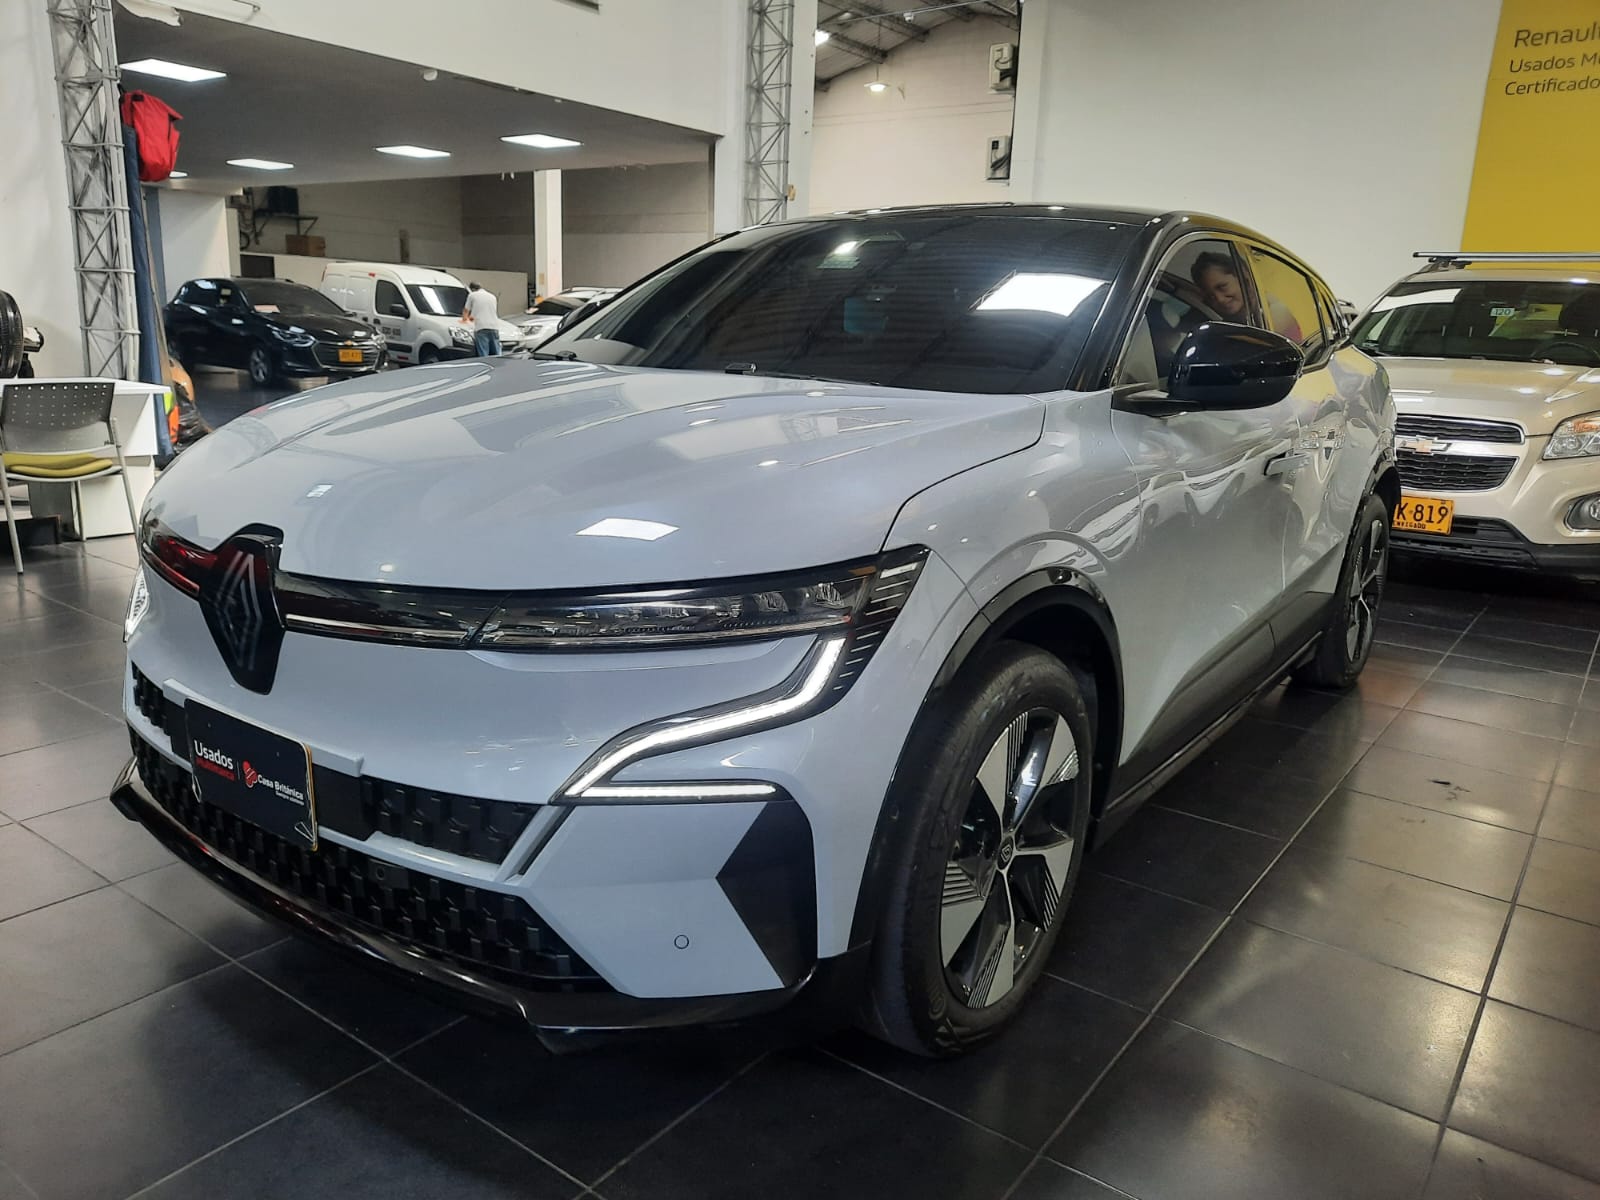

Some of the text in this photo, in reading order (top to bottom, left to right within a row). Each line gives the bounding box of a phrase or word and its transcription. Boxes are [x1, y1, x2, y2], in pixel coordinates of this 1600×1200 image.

[1514, 21, 1600, 48] Renaul
[1510, 52, 1600, 73] Usados M
[1505, 75, 1600, 95] Certificado
[194, 739, 234, 770] Usados
[257, 774, 274, 788] Casa
